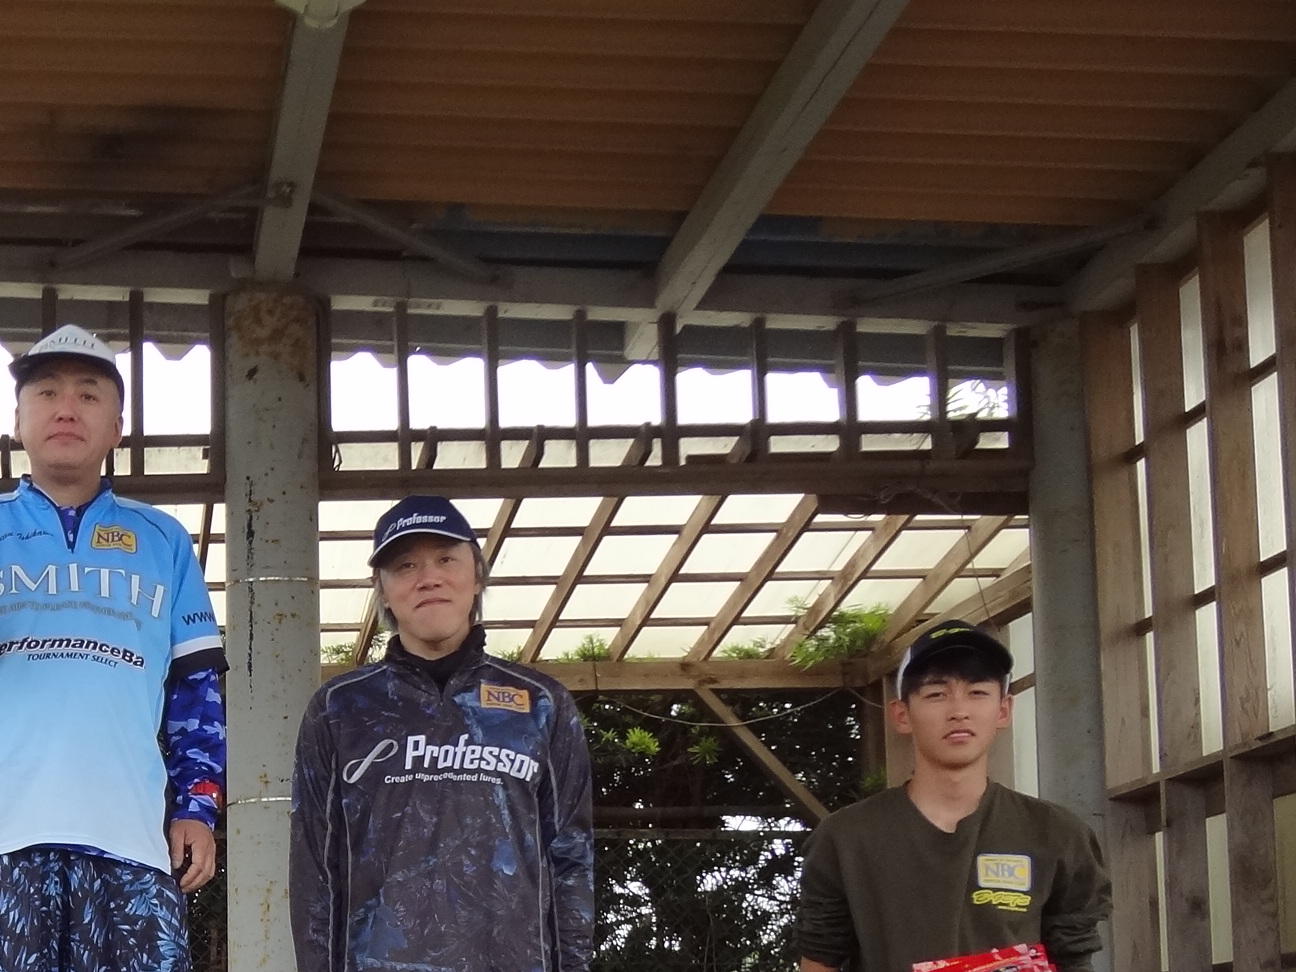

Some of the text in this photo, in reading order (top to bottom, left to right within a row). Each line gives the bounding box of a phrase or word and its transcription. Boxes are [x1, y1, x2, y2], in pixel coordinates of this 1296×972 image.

[396, 513, 447, 530] Professor
[95, 530, 133, 548] NBC
[27, 651, 119, 668] TOURNAMENT SELECT
[486, 689, 524, 707] NBC
[404, 733, 539, 783] Professor
[384, 774, 414, 784] Create
[479, 772, 504, 785] lures.
